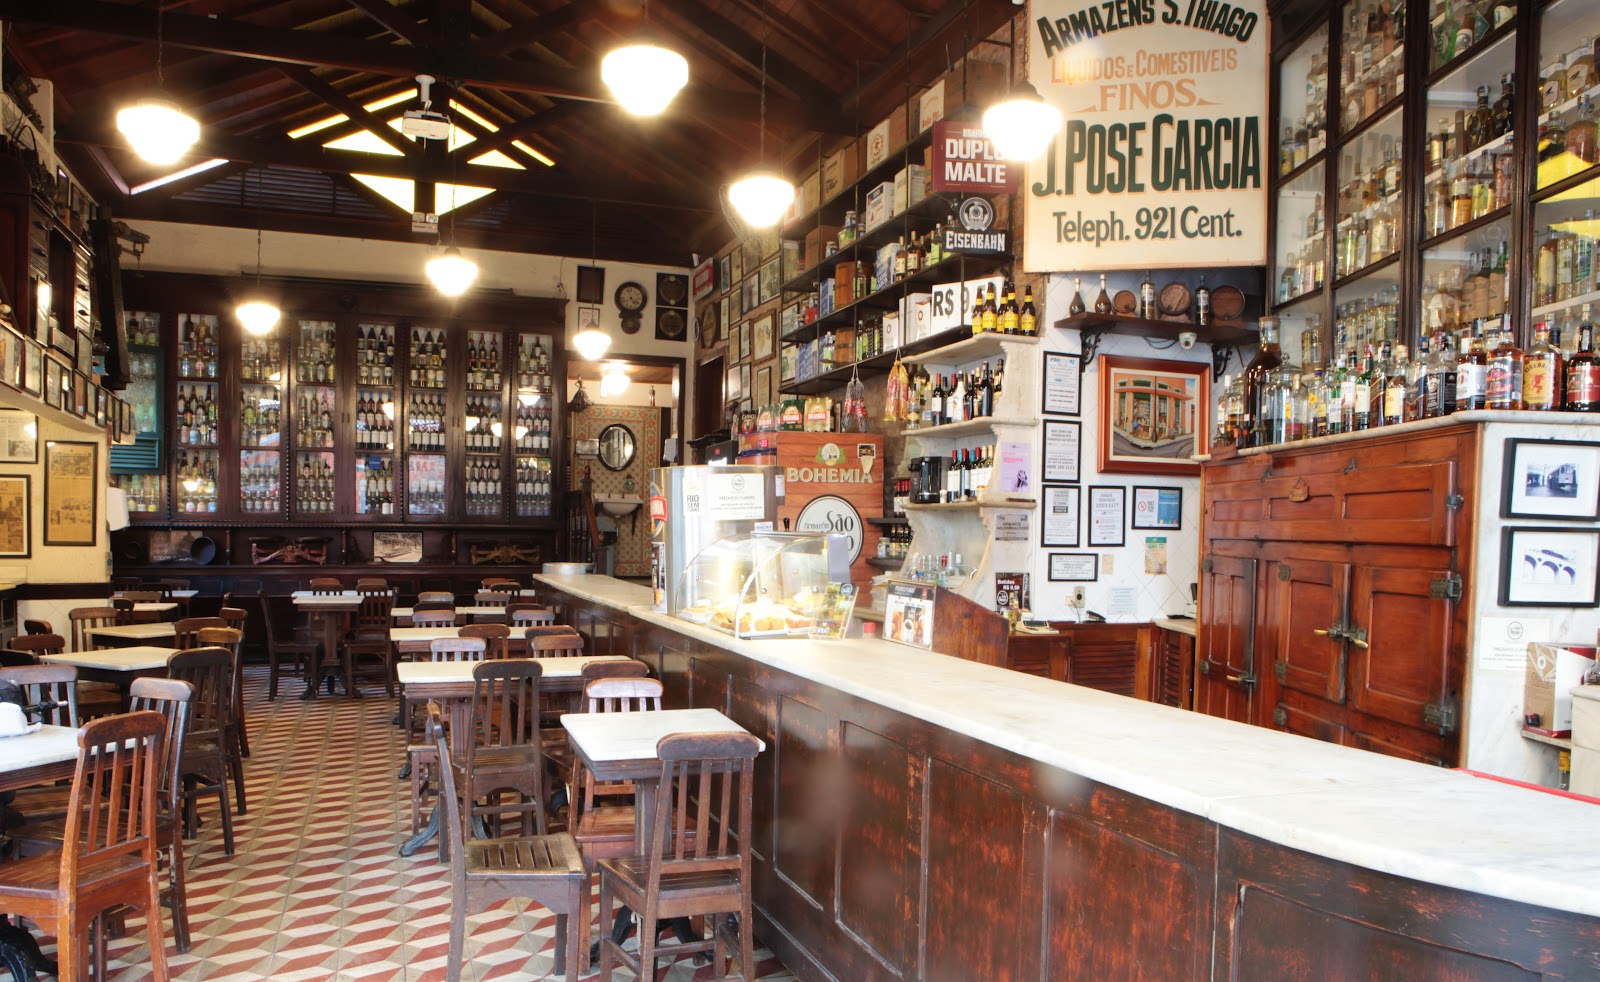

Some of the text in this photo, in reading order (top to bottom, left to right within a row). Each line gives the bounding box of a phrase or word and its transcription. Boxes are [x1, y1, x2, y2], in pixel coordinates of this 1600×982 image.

[1036, 0, 1155, 59] ARMAZENS
[1135, 47, 1239, 78] COMESTIVEIS
[1099, 78, 1198, 112] FINOS
[1151, 112, 1262, 193] GARCIA
[944, 161, 1007, 184] MALTE
[1052, 205, 1243, 248] Teleph. 921 Cent.
[945, 230, 1006, 252] EISENBAHN
[786, 467, 874, 484] BOHEMIA
[686, 495, 700, 503] RIO
[826, 510, 854, 532] São
